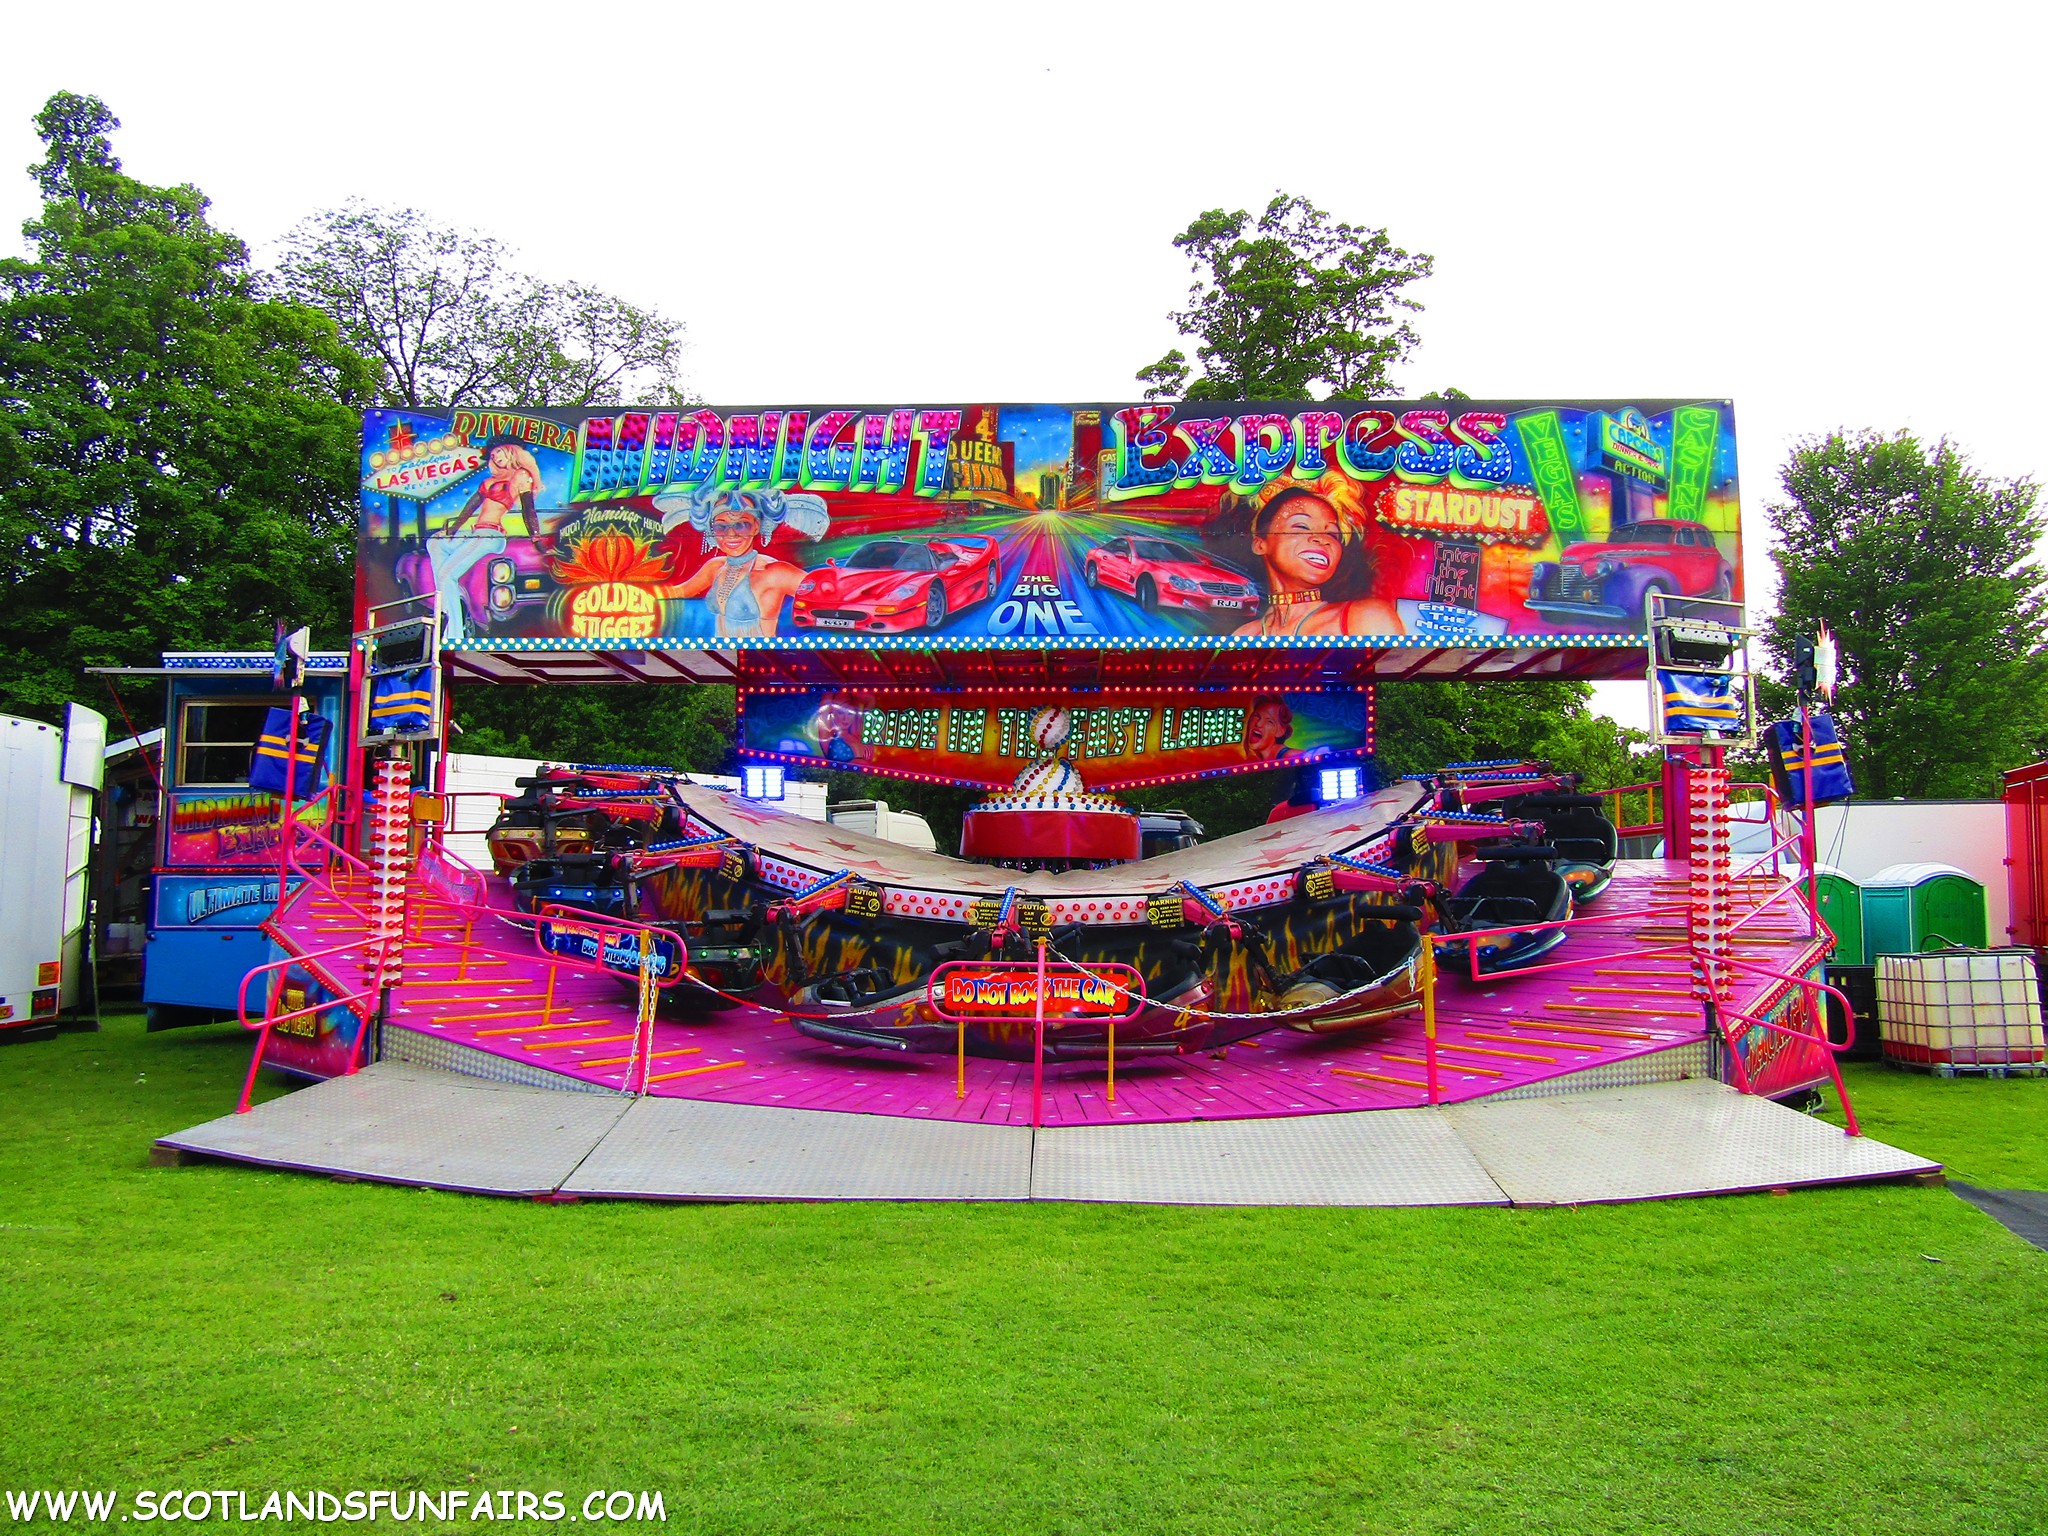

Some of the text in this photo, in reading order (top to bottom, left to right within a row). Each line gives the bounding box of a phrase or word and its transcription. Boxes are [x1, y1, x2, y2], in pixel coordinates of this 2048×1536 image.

[452, 411, 578, 454] RIVIERA
[572, 408, 961, 500] MIDNIGHT
[1673, 409, 1711, 521] CASINO
[377, 455, 480, 489] LAS VEGAS
[1519, 416, 1577, 529] VEGAS
[1614, 460, 1656, 485] ACTION
[404, 478, 448, 491] NEVADA
[583, 506, 642, 530] Flamingo
[1395, 487, 1534, 531] STARDUST
[1434, 541, 1478, 564] Enter
[1440, 558, 1468, 580] the
[573, 583, 656, 614] GOLDEN
[1012, 584, 1061, 597] BIG
[1424, 573, 1475, 606] Night
[1217, 599, 1239, 608] RJJ
[1418, 602, 1479, 618] ENTER
[572, 614, 656, 638] NUGGET
[987, 600, 1100, 635] ONE
[1416, 619, 1477, 634] NIGHT
[1429, 611, 1467, 625] THE
[862, 706, 1245, 760] RIDE IN TH FAST LANE
[1306, 869, 1332, 880] WARNING
[188, 884, 261, 923] ULTIMATE
[848, 887, 878, 897] CAUTION
[1149, 898, 1183, 907] WARNING
[952, 978, 975, 1003] DO
[976, 982, 1008, 1006] NOT
[1053, 977, 1080, 999] THE
[1082, 979, 1116, 1007] CAR
[895, 1003, 917, 1027] 3
